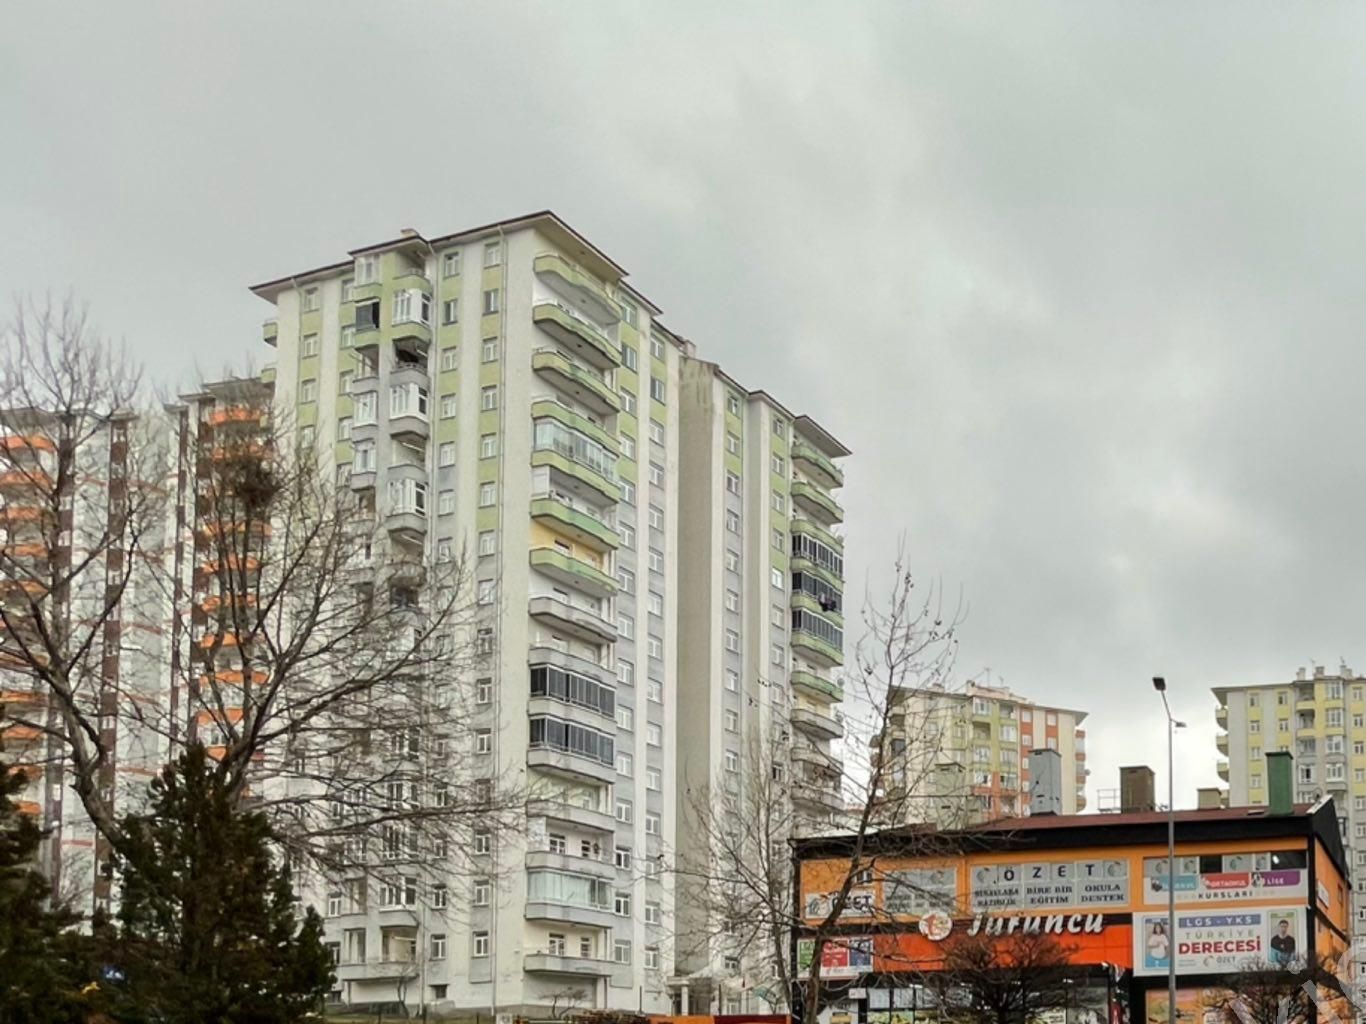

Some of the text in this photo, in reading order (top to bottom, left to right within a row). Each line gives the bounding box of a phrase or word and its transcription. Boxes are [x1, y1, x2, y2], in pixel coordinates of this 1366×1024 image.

[1026, 885, 1073, 895] BİRE BİR
[1084, 884, 1121, 893] OKULA
[1081, 893, 1124, 902] DESTEK
[1198, 891, 1253, 899] KURSLARI
[1030, 896, 1069, 905] EĞİTİM
[1186, 917, 1212, 926] LGS
[1226, 915, 1252, 925] YKS
[1185, 928, 1255, 940] TÜRKİYE
[1178, 935, 1261, 955] DERECESİ
